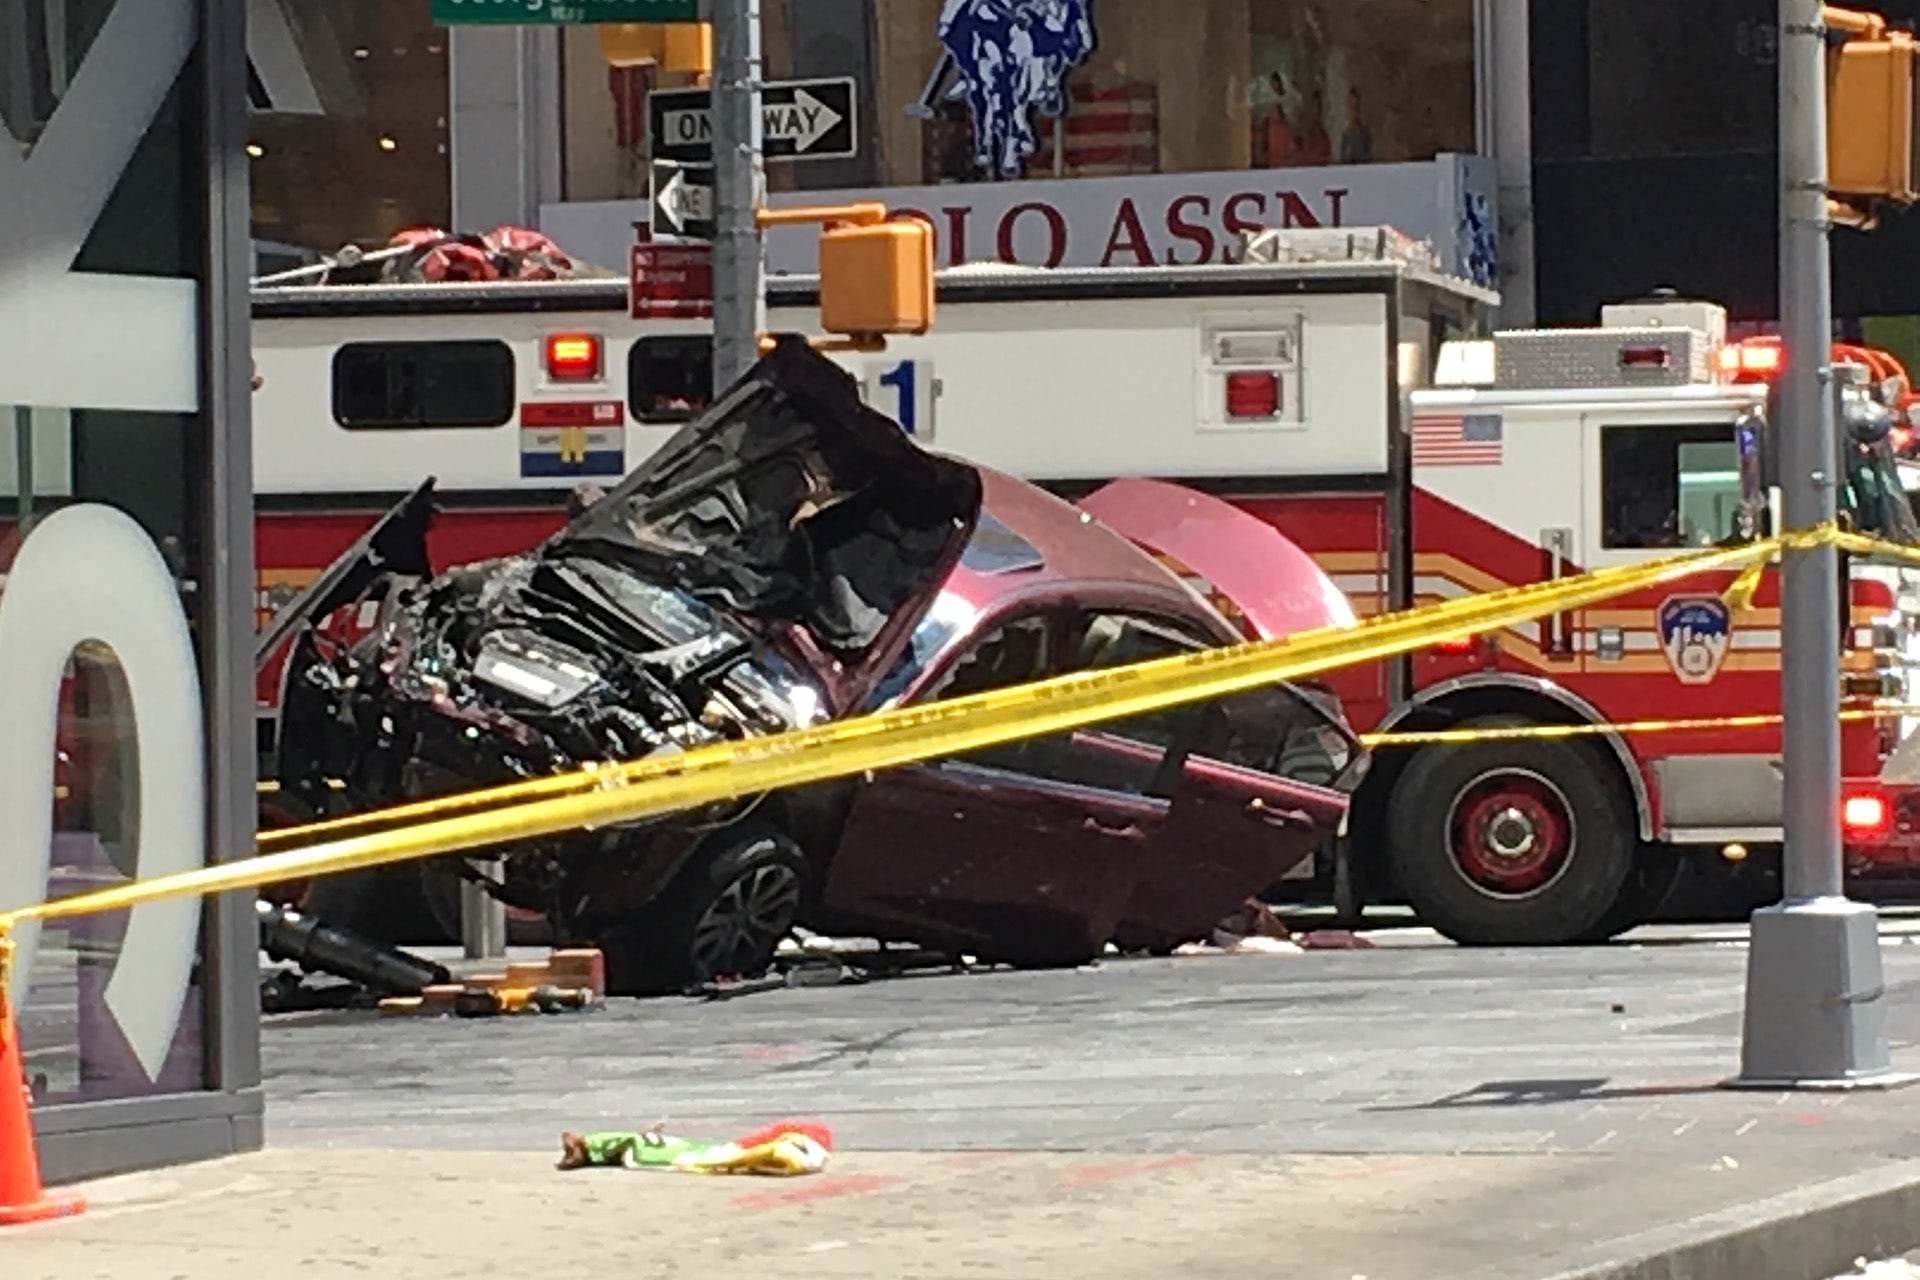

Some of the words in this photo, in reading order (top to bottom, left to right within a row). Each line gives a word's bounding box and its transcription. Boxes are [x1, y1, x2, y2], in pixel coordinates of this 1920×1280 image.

[679, 113, 712, 141] ON
[763, 106, 821, 134] WAY
[880, 360, 914, 434] 1
